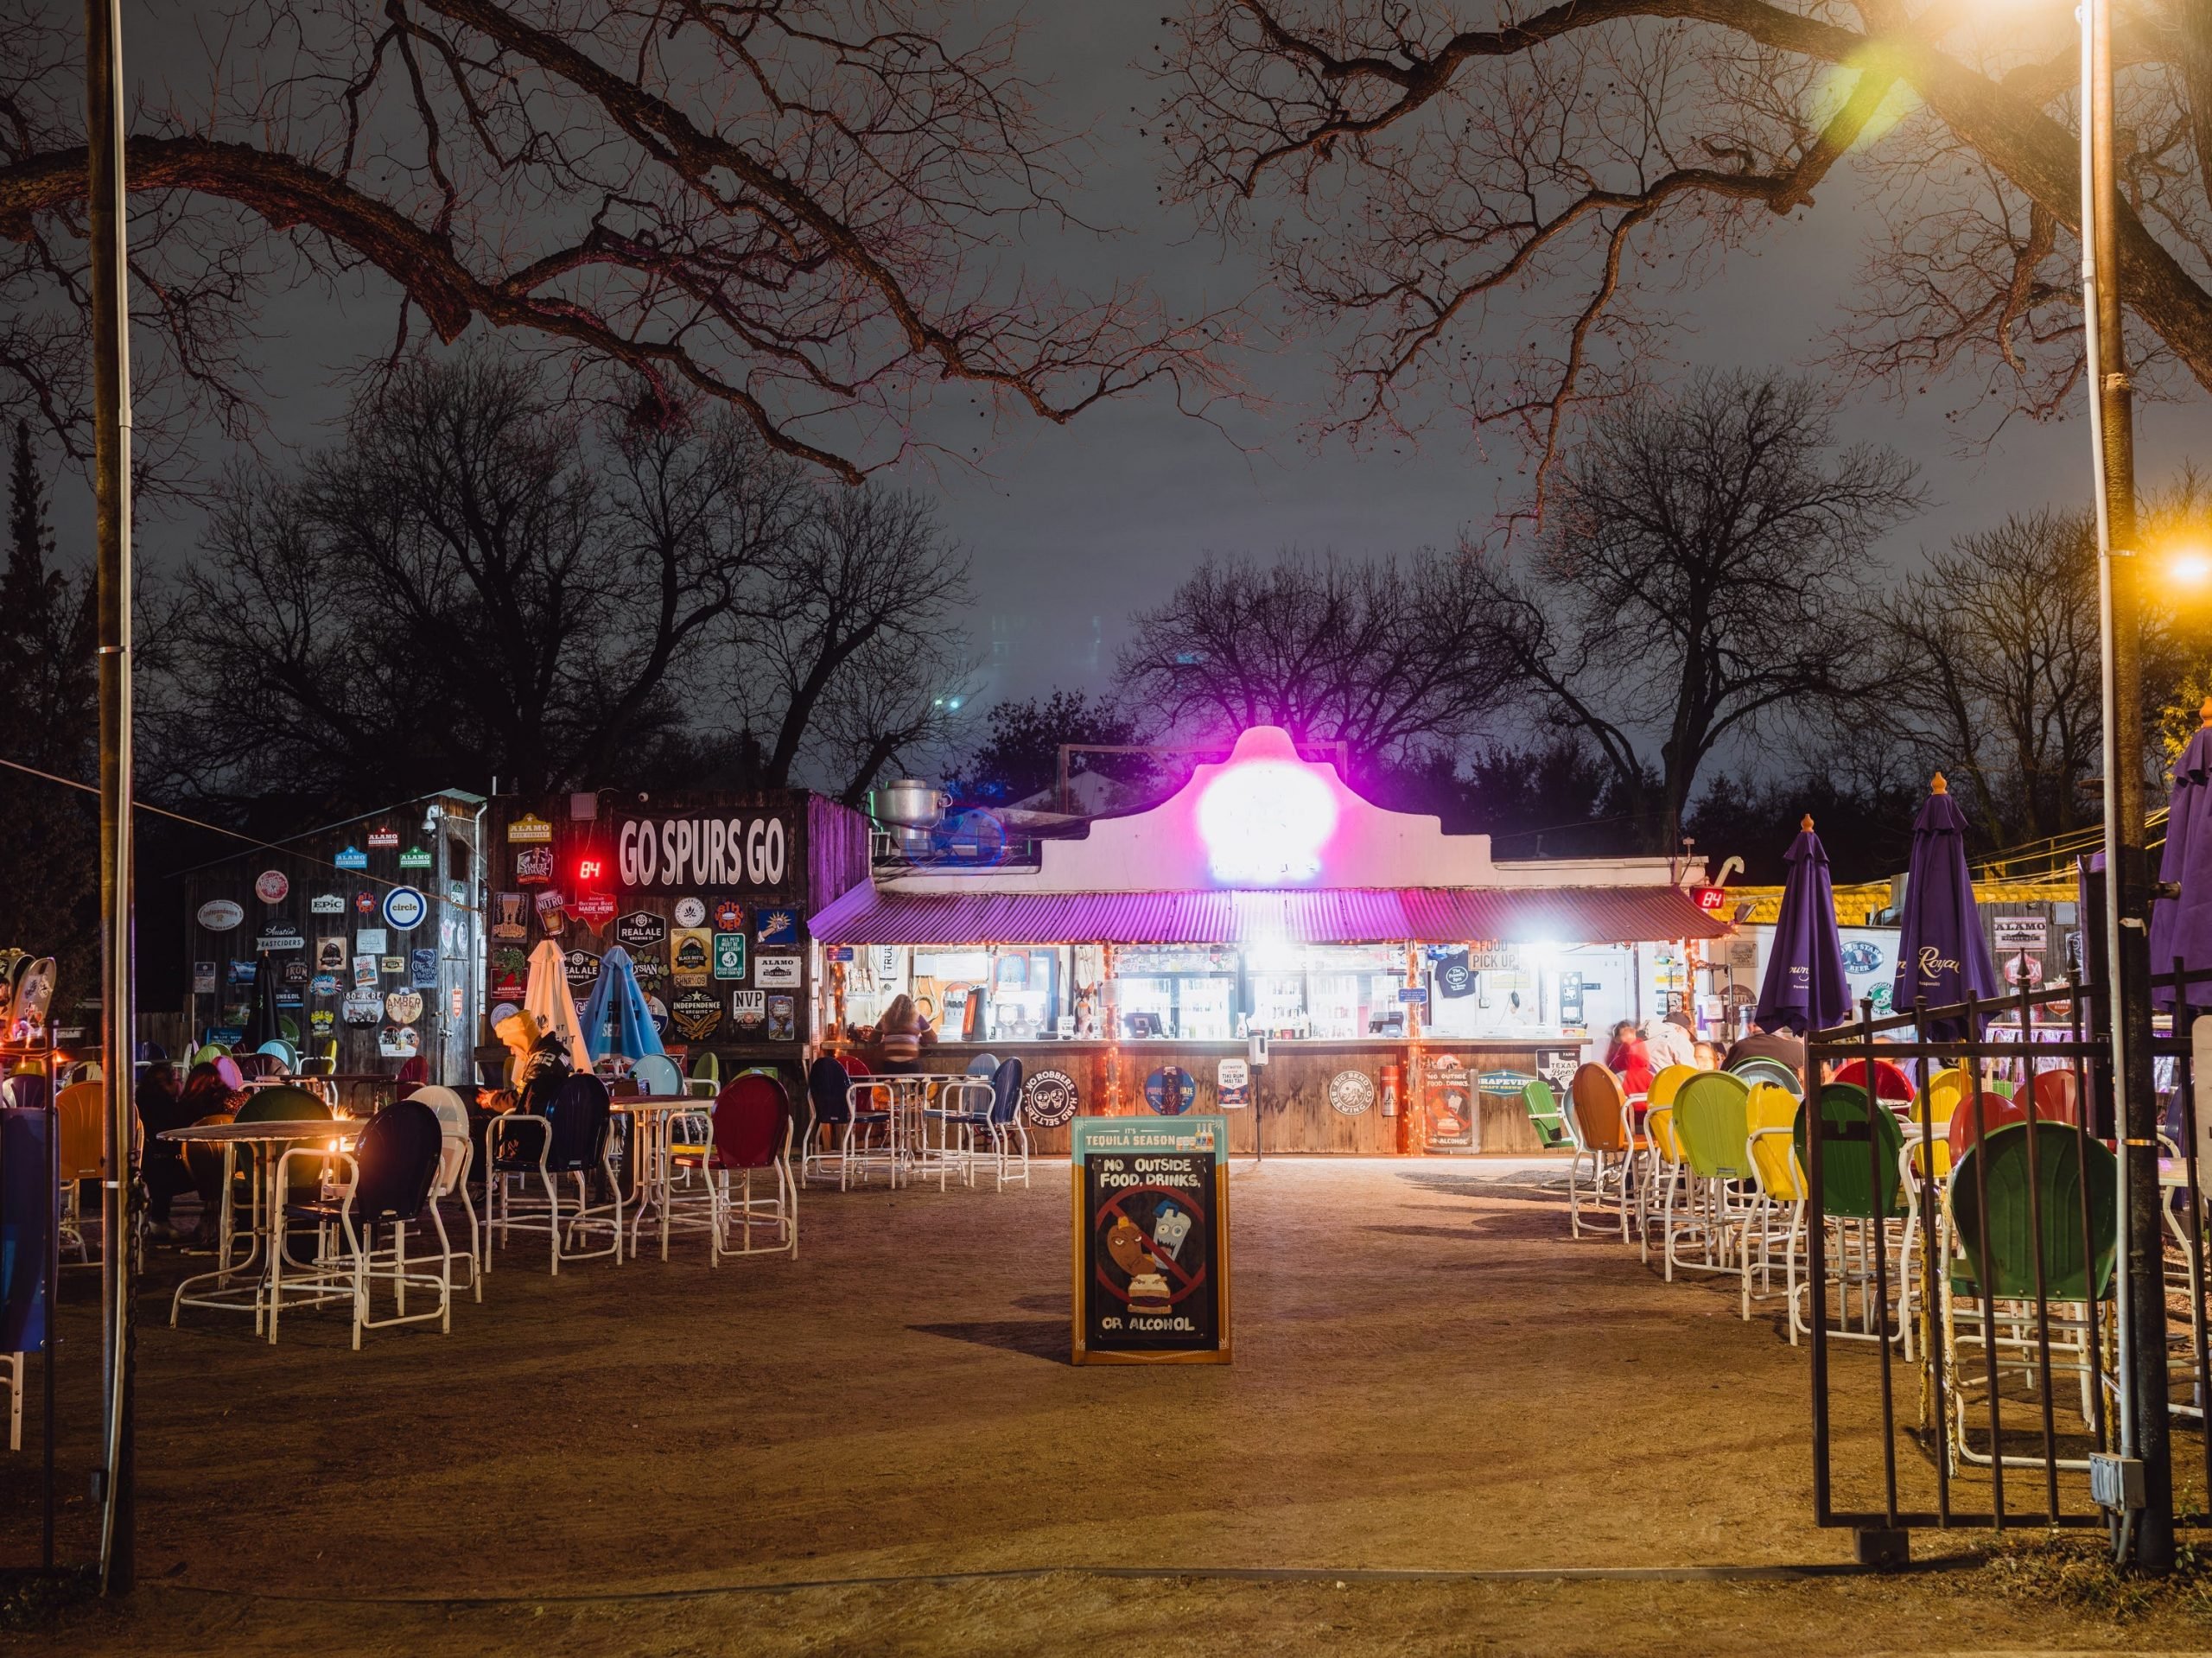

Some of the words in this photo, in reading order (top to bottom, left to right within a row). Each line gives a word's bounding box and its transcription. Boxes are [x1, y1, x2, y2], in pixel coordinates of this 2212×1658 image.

[620, 820, 657, 886] GO
[662, 818, 742, 886] SPURS
[747, 817, 785, 885] GO
[518, 862, 550, 871] SAMUEL
[524, 867, 547, 875] ADAMS
[580, 861, 601, 879] 84
[537, 895, 563, 911] NITRO
[1702, 892, 1722, 906] 84
[392, 903, 417, 912] circle
[264, 925, 296, 937] Austin
[622, 928, 643, 937] REAL
[645, 928, 661, 937] ALE
[261, 939, 302, 948] EASTCIDERS
[1479, 940, 1509, 952] FOOD
[1859, 943, 1882, 955] STAR
[883, 945, 893, 971] TRUL
[1472, 955, 1497, 968] PICK
[1501, 955, 1516, 967] UP
[285, 966, 308, 977] IRON
[632, 963, 658, 975] LYSIAN
[346, 992, 381, 1001] 80-ACRE
[387, 996, 421, 1008] AMBER
[736, 992, 763, 1007] NVP
[1333, 1073, 1347, 1087] BIG
[1347, 1071, 1370, 1087] BEND
[1551, 1068, 1575, 1077] Beer
[1026, 1077, 1038, 1091] NO
[1036, 1070, 1075, 1091] ROBBERS
[1478, 1077, 1530, 1086] RAPEVIN
[1061, 1096, 1078, 1121] HARD
[1331, 1090, 1366, 1114] BREWING
[1365, 1090, 1372, 1103] CO
[1085, 1135, 1130, 1147] TEQUILA
[1133, 1134, 1176, 1146] SEASON
[1103, 1159, 1124, 1172] NO
[1135, 1158, 1192, 1172] OUTSIDE
[1100, 1173, 1143, 1188] FOOD,
[1146, 1173, 1201, 1188] DRINKS,
[1102, 1317, 1122, 1330] OR
[1128, 1317, 1196, 1331] ALCOHOL
